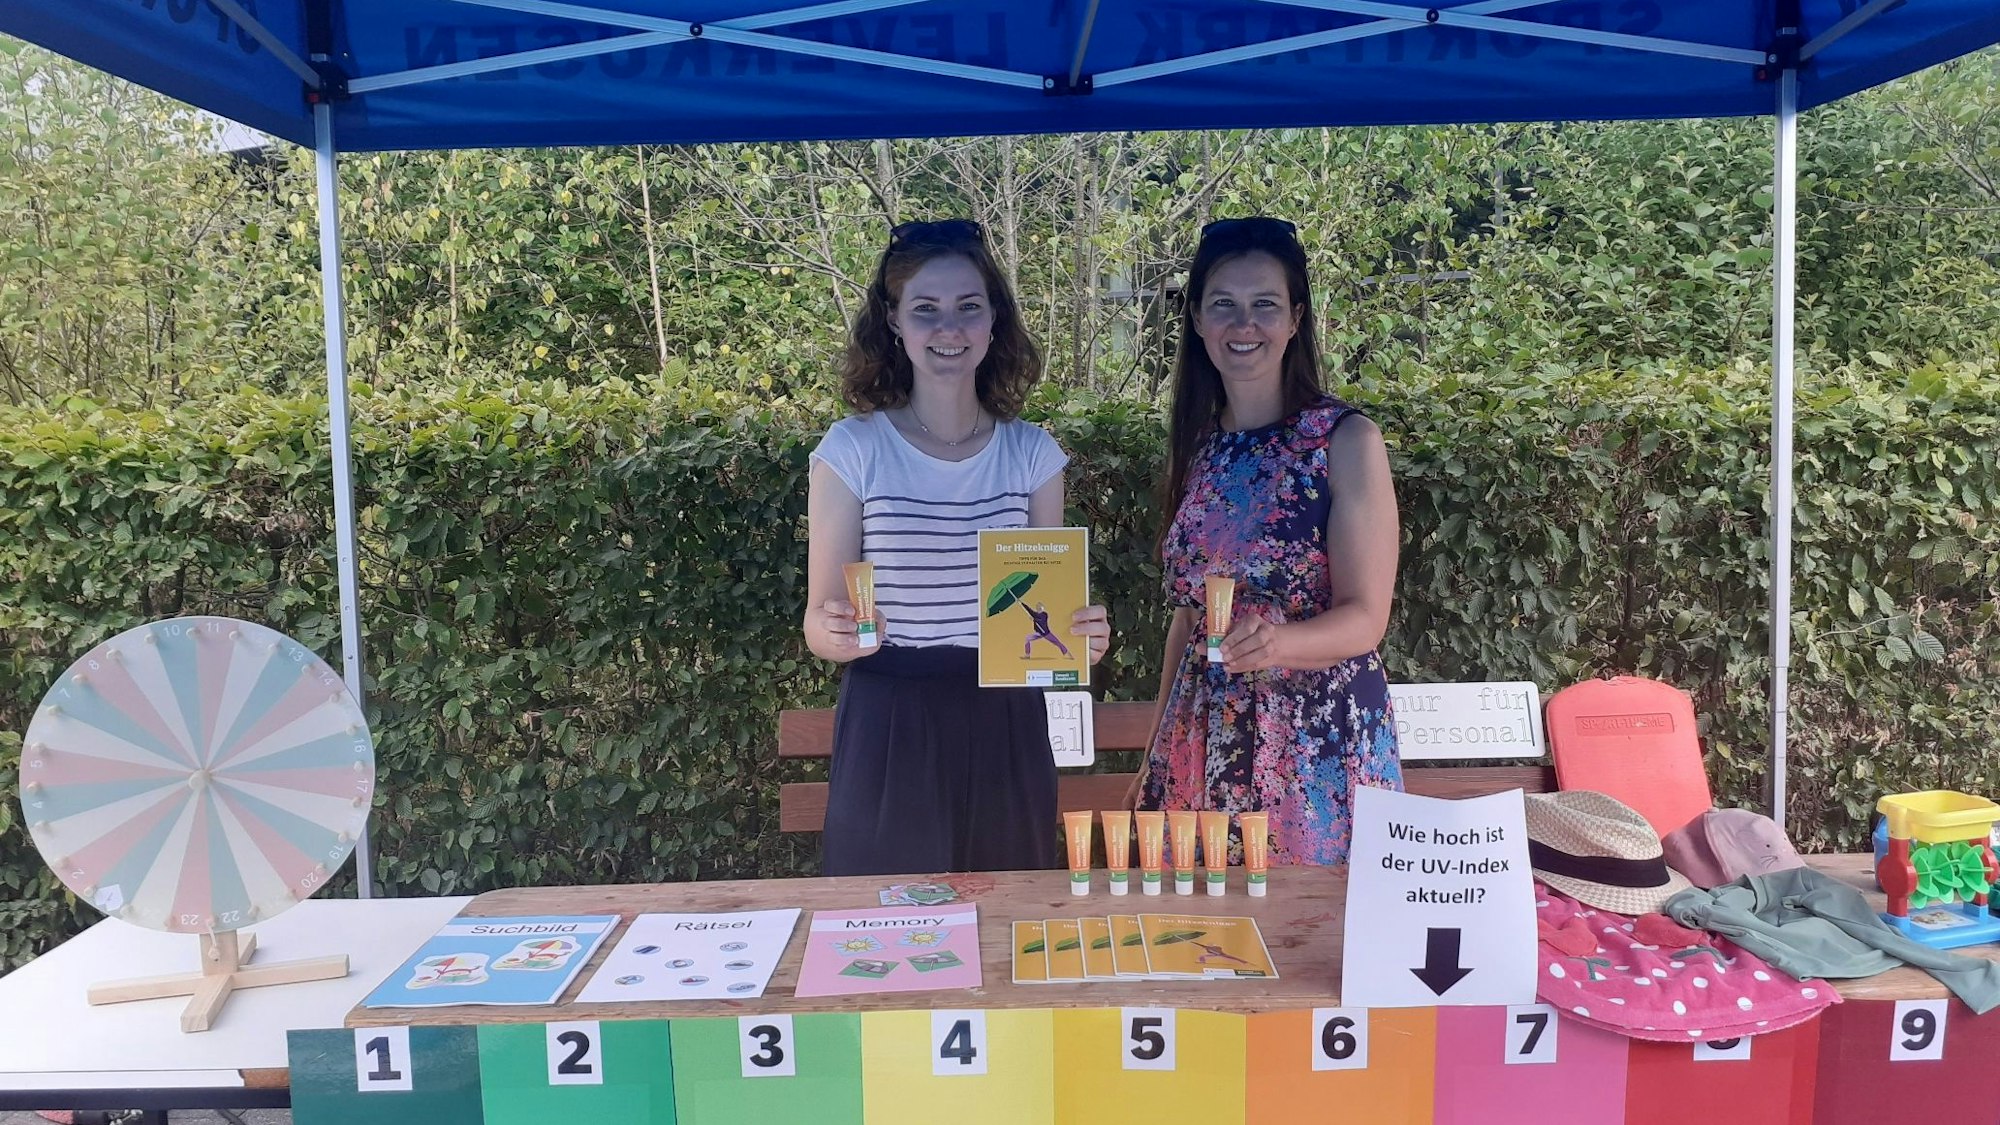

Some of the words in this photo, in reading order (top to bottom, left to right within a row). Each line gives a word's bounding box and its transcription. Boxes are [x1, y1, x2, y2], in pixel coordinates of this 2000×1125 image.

[996, 544, 1012, 552] Der
[1014, 543, 1069, 553] Hitzeknigge
[163, 624, 180, 637] 10
[206, 622, 221, 633] 11
[288, 647, 304, 662] 13
[88, 659, 100, 671] 8
[58, 687, 71, 699] 7
[1391, 694, 1442, 713] nur
[1477, 687, 1526, 711] für
[1048, 699, 1081, 720] ür
[1395, 717, 1532, 745] Personal
[352, 737, 366, 753] 16
[30, 759, 43, 768] 5
[356, 778, 369, 794] 17
[1388, 822, 1426, 843] Wie
[1433, 828, 1480, 845] hoch
[1486, 826, 1505, 843] ist
[328, 844, 344, 860] 19
[1381, 853, 1415, 873] der
[1422, 858, 1510, 875] UV-Index
[71, 868, 85, 880] 2
[301, 871, 319, 889] 20
[1406, 887, 1486, 904] aktuell?
[180, 914, 199, 926] 23
[222, 910, 240, 924] 22
[845, 918, 945, 929] Memory
[470, 923, 578, 935] Suchbild
[674, 920, 753, 931] Rätsel
[1130, 1017, 1165, 1060] 5
[1321, 1017, 1357, 1060] 6
[1516, 1013, 1549, 1055] 7
[1900, 1009, 1937, 1052] 9
[748, 1024, 784, 1067] 3
[940, 1019, 977, 1065] 4
[365, 1035, 402, 1081] 1
[557, 1030, 593, 1075] 2
